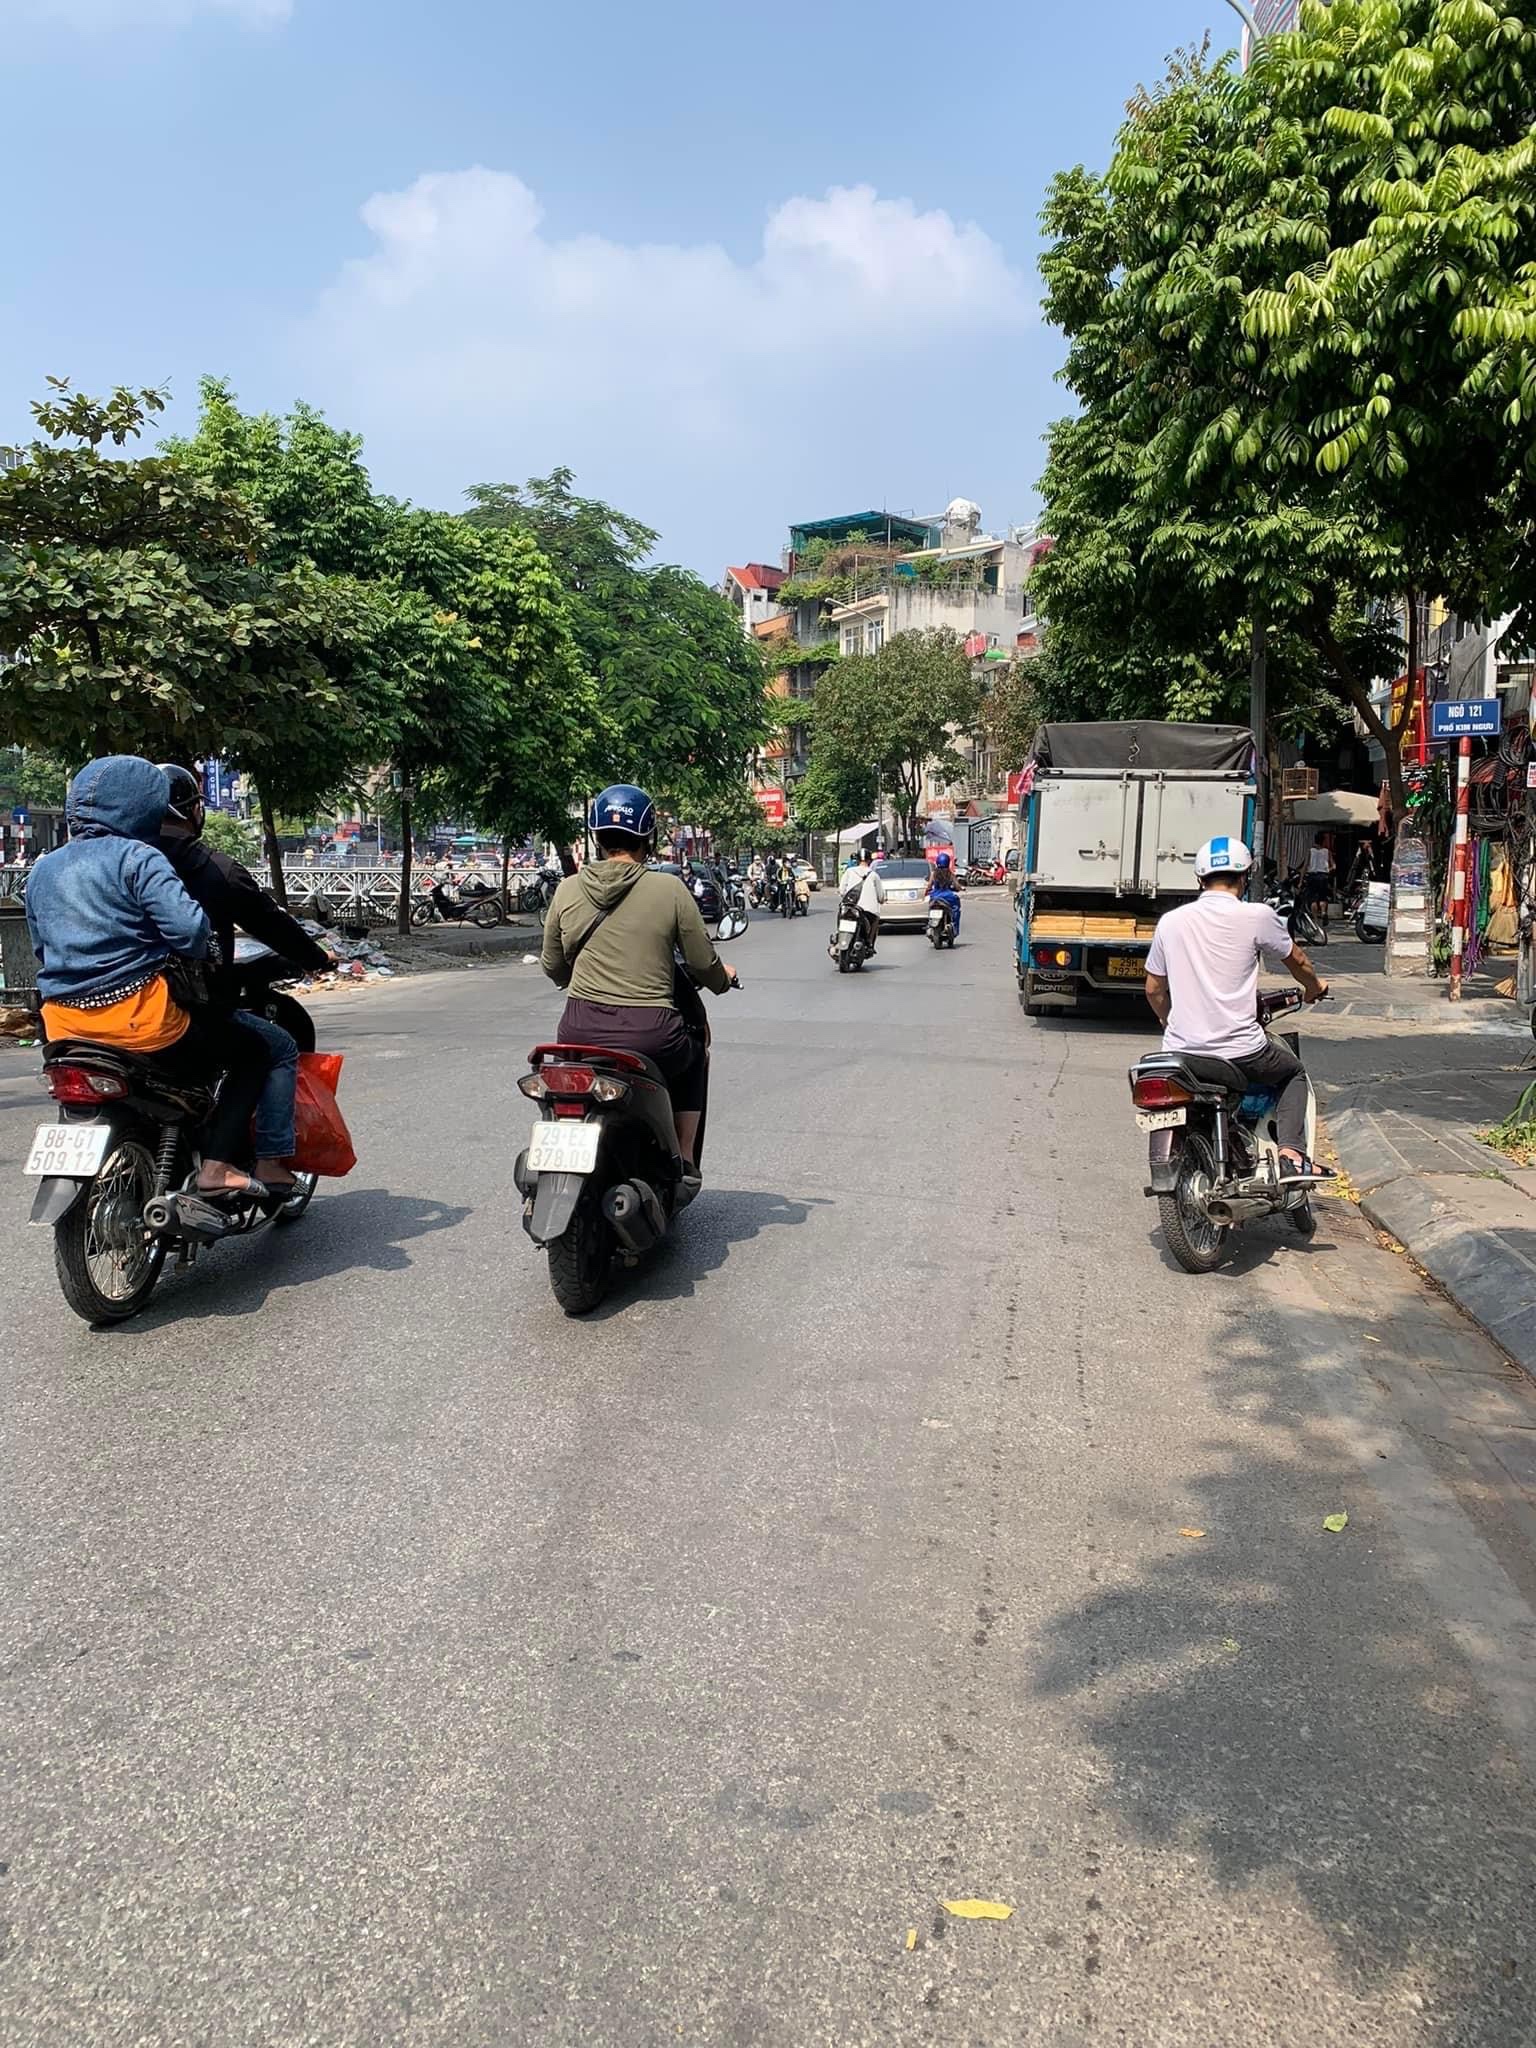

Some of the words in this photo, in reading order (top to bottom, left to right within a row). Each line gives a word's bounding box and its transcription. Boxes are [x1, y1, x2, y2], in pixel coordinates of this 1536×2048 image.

[1469, 704, 1483, 717] 121
[1455, 723, 1471, 731] KIM
[1033, 983, 1075, 992] FRONTIER
[44, 1128, 96, 1149] 88-G1
[31, 1150, 96, 1172] 509.12
[532, 1147, 592, 1169] 378.09
